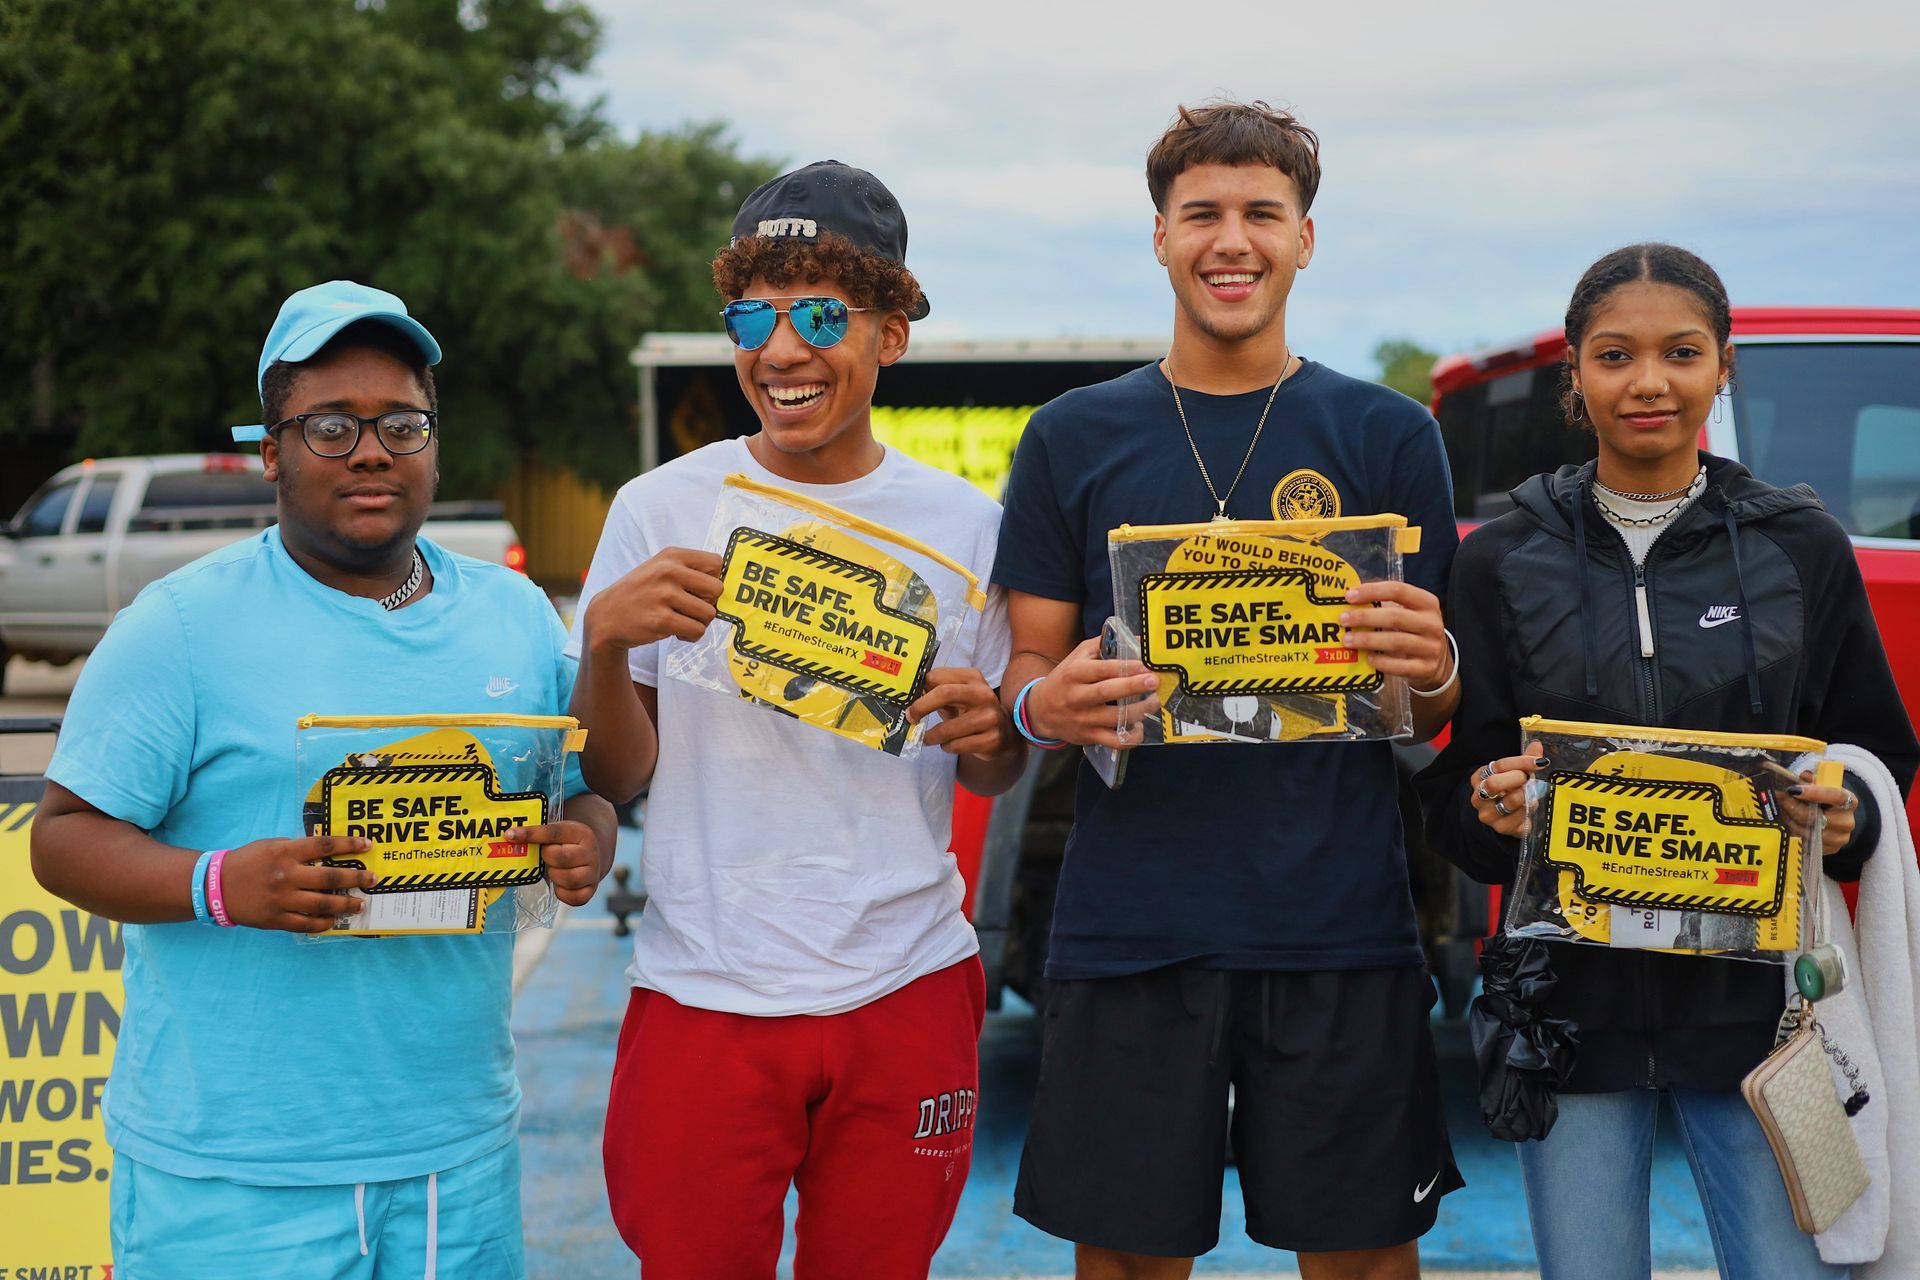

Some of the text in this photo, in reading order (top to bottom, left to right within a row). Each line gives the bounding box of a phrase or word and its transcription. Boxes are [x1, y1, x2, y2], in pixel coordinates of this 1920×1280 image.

[1193, 535, 1346, 573] IT WOULD BEHOOF
[1182, 548, 1216, 565] YOU
[1220, 555, 1241, 569] TO
[1312, 572, 1350, 591] OWN.
[742, 560, 856, 616] BE SAFE.
[735, 583, 909, 658] DRIVE SMART.
[1164, 601, 1292, 626] BE SAFE.
[1706, 605, 1738, 619] NIKE
[763, 620, 859, 660] #EndTheStreakTX
[1165, 622, 1341, 650] DRIVE SMAR
[1203, 652, 1309, 667] #EndTheStreakTX
[347, 796, 469, 821] BE SAFE.
[1568, 803, 1697, 836] BE SAFE.
[346, 821, 430, 844] DRIVE
[1566, 827, 1763, 866] DRIVE SMART.
[382, 846, 483, 861] #EndTheStreakTX
[208, 858, 221, 891] Team
[1601, 861, 1709, 881] #EndTheStreakTX
[1584, 902, 1598, 925] YO
